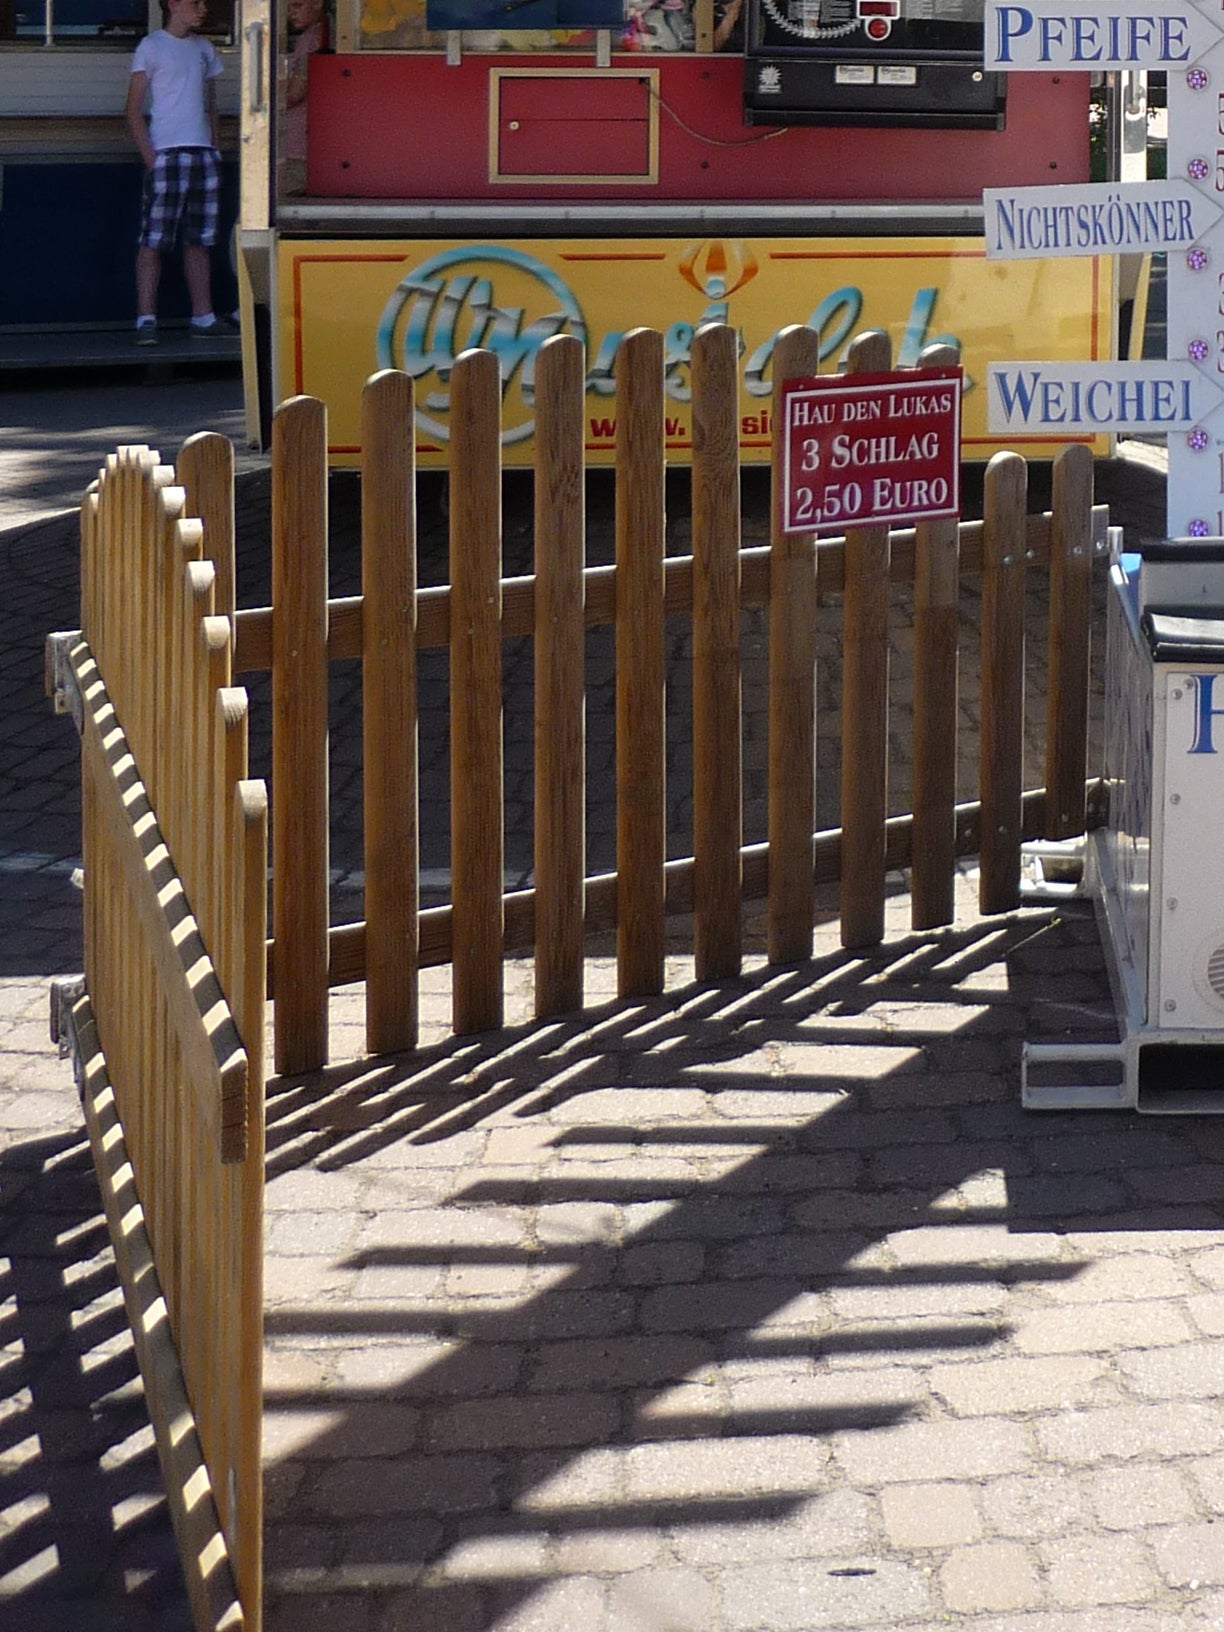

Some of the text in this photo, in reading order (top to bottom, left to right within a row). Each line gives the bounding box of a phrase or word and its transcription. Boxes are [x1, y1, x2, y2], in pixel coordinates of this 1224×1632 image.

[996, 7, 1190, 62] PFEIFE
[998, 194, 1194, 249] NICHTSKÖNNER
[793, 402, 835, 427] HAU
[842, 400, 881, 423] DEN
[888, 394, 951, 417] LUKAS
[998, 373, 1192, 422] WEICHEI
[802, 432, 939, 470] 3 SCHLAG
[796, 477, 948, 522] 2,50 EURO
